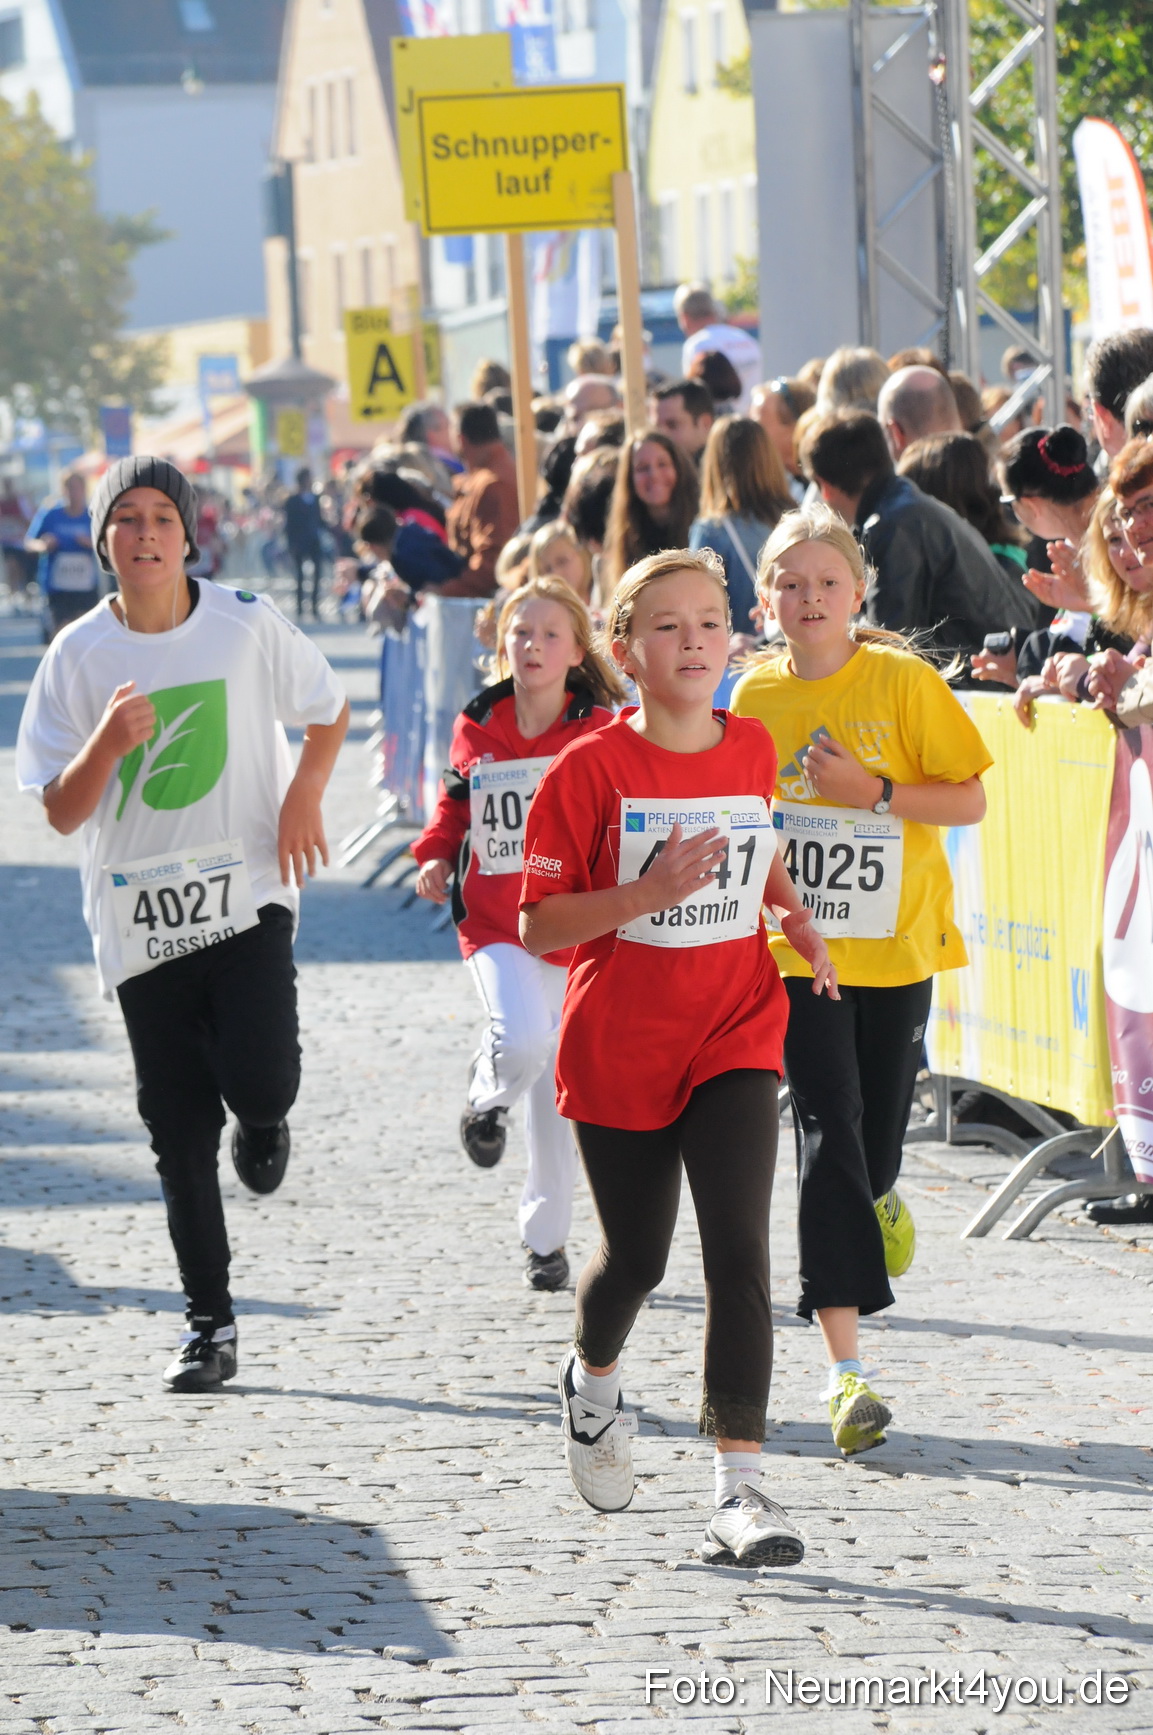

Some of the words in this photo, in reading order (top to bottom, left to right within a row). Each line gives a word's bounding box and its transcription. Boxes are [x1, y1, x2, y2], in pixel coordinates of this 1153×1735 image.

[432, 131, 613, 162] Schnupper-
[496, 167, 553, 197] lauf
[368, 343, 405, 395] A
[481, 769, 528, 783] PFLEIDERER
[780, 773, 822, 801] adi
[482, 787, 538, 831] 40
[648, 811, 716, 825] PFLEIDERER
[730, 812, 761, 824] BOCK
[785, 813, 838, 831] PFLEIDERER
[487, 837, 525, 858] Car
[126, 862, 185, 881] PFLEIDERER
[783, 838, 884, 892] 4025
[133, 873, 231, 931] 4027
[651, 896, 739, 927] Jasmin
[802, 892, 851, 920] Nina
[147, 926, 237, 960] Cassian
